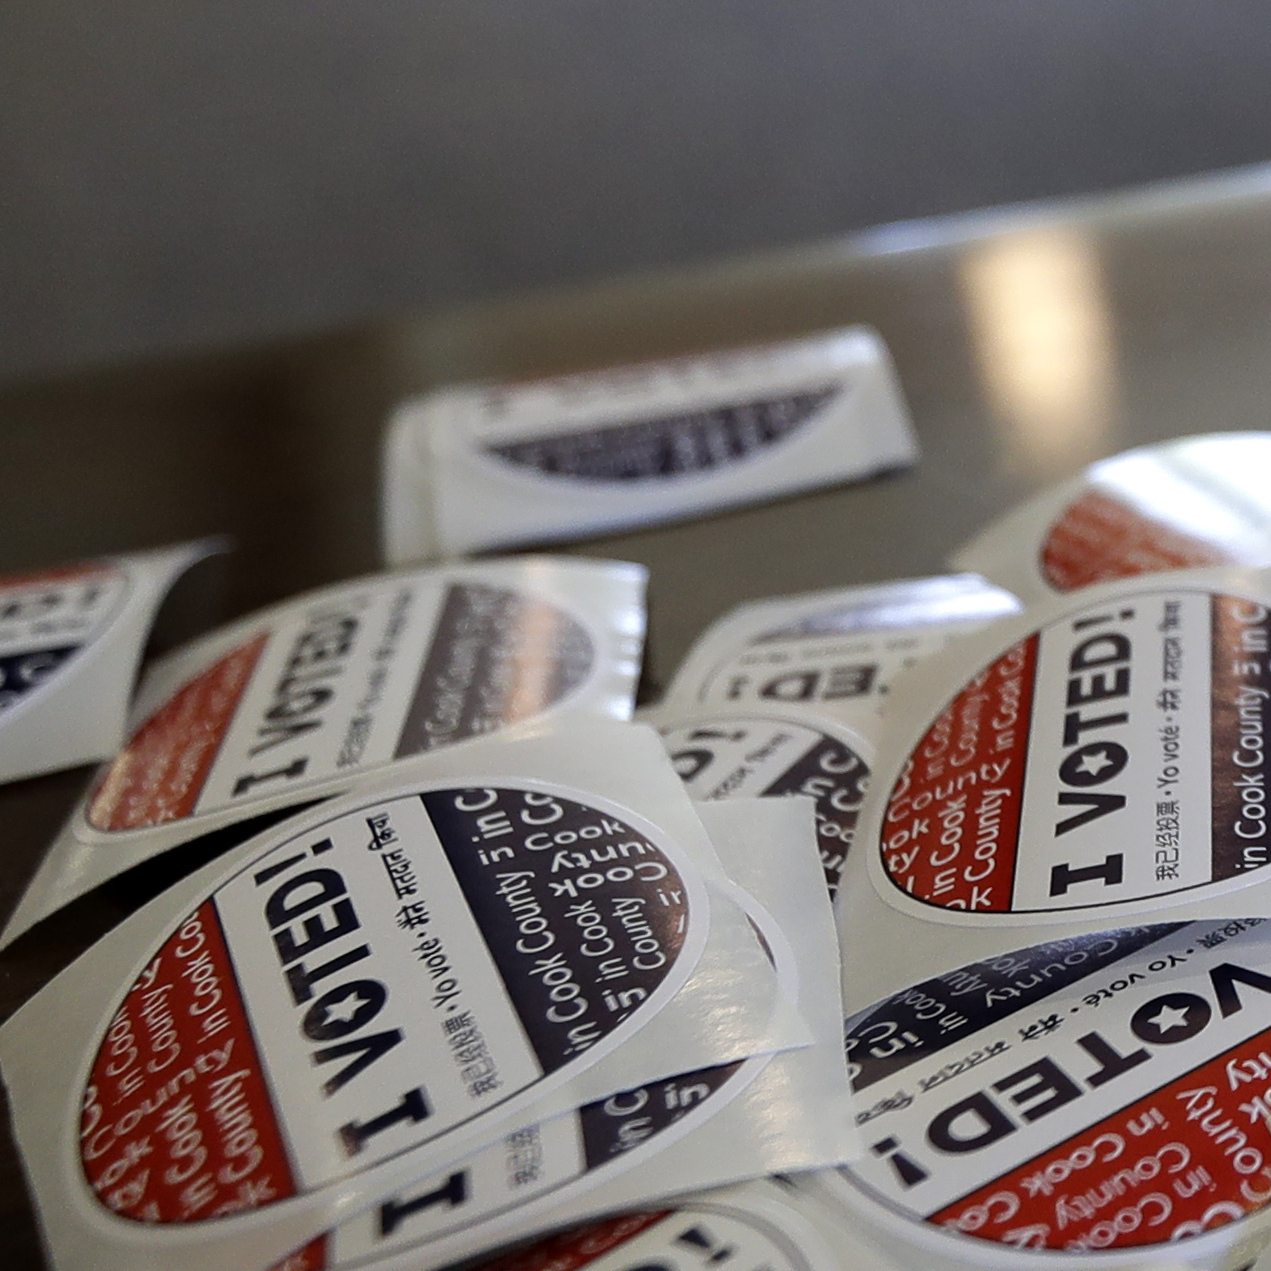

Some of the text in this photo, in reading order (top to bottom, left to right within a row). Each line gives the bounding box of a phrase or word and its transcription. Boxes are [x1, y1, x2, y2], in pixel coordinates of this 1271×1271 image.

[1233, 628, 1267, 652] in
[231, 755, 309, 797] I
[991, 730, 1015, 755] in
[1050, 609, 1134, 897] I VOTED!
[1157, 724, 1181, 789] Yo voté
[1233, 684, 1270, 870] in Cook County
[887, 758, 1011, 823] County
[472, 811, 514, 843] in
[524, 819, 625, 850] Cook
[924, 793, 967, 900] in Cook
[964, 781, 1011, 882] County
[1156, 799, 1180, 880] 我已经投票
[549, 861, 667, 898] Cook
[253, 838, 406, 1099] VOTED!
[495, 871, 601, 1055] in Cook County
[564, 900, 629, 983] in Cook
[612, 898, 666, 970] County
[181, 951, 230, 1044] in Cook
[413, 937, 462, 1008] Yo voté
[985, 939, 1119, 1008] County
[1082, 954, 1186, 1008] Yo voté
[140, 984, 180, 1073] County
[869, 1031, 925, 1058] in
[896, 989, 968, 1034] in Cook
[113, 1067, 145, 1106] in
[441, 1011, 504, 1096] 我已经投票
[84, 1038, 235, 1160] County
[208, 1068, 263, 1182] County
[332, 1084, 435, 1157] I
[156, 1095, 207, 1184] Cook
[1021, 1107, 1169, 1197] in Cook
[379, 1170, 471, 1235] I
[1055, 1142, 1192, 1229] County
[1172, 1166, 1217, 1199] in
